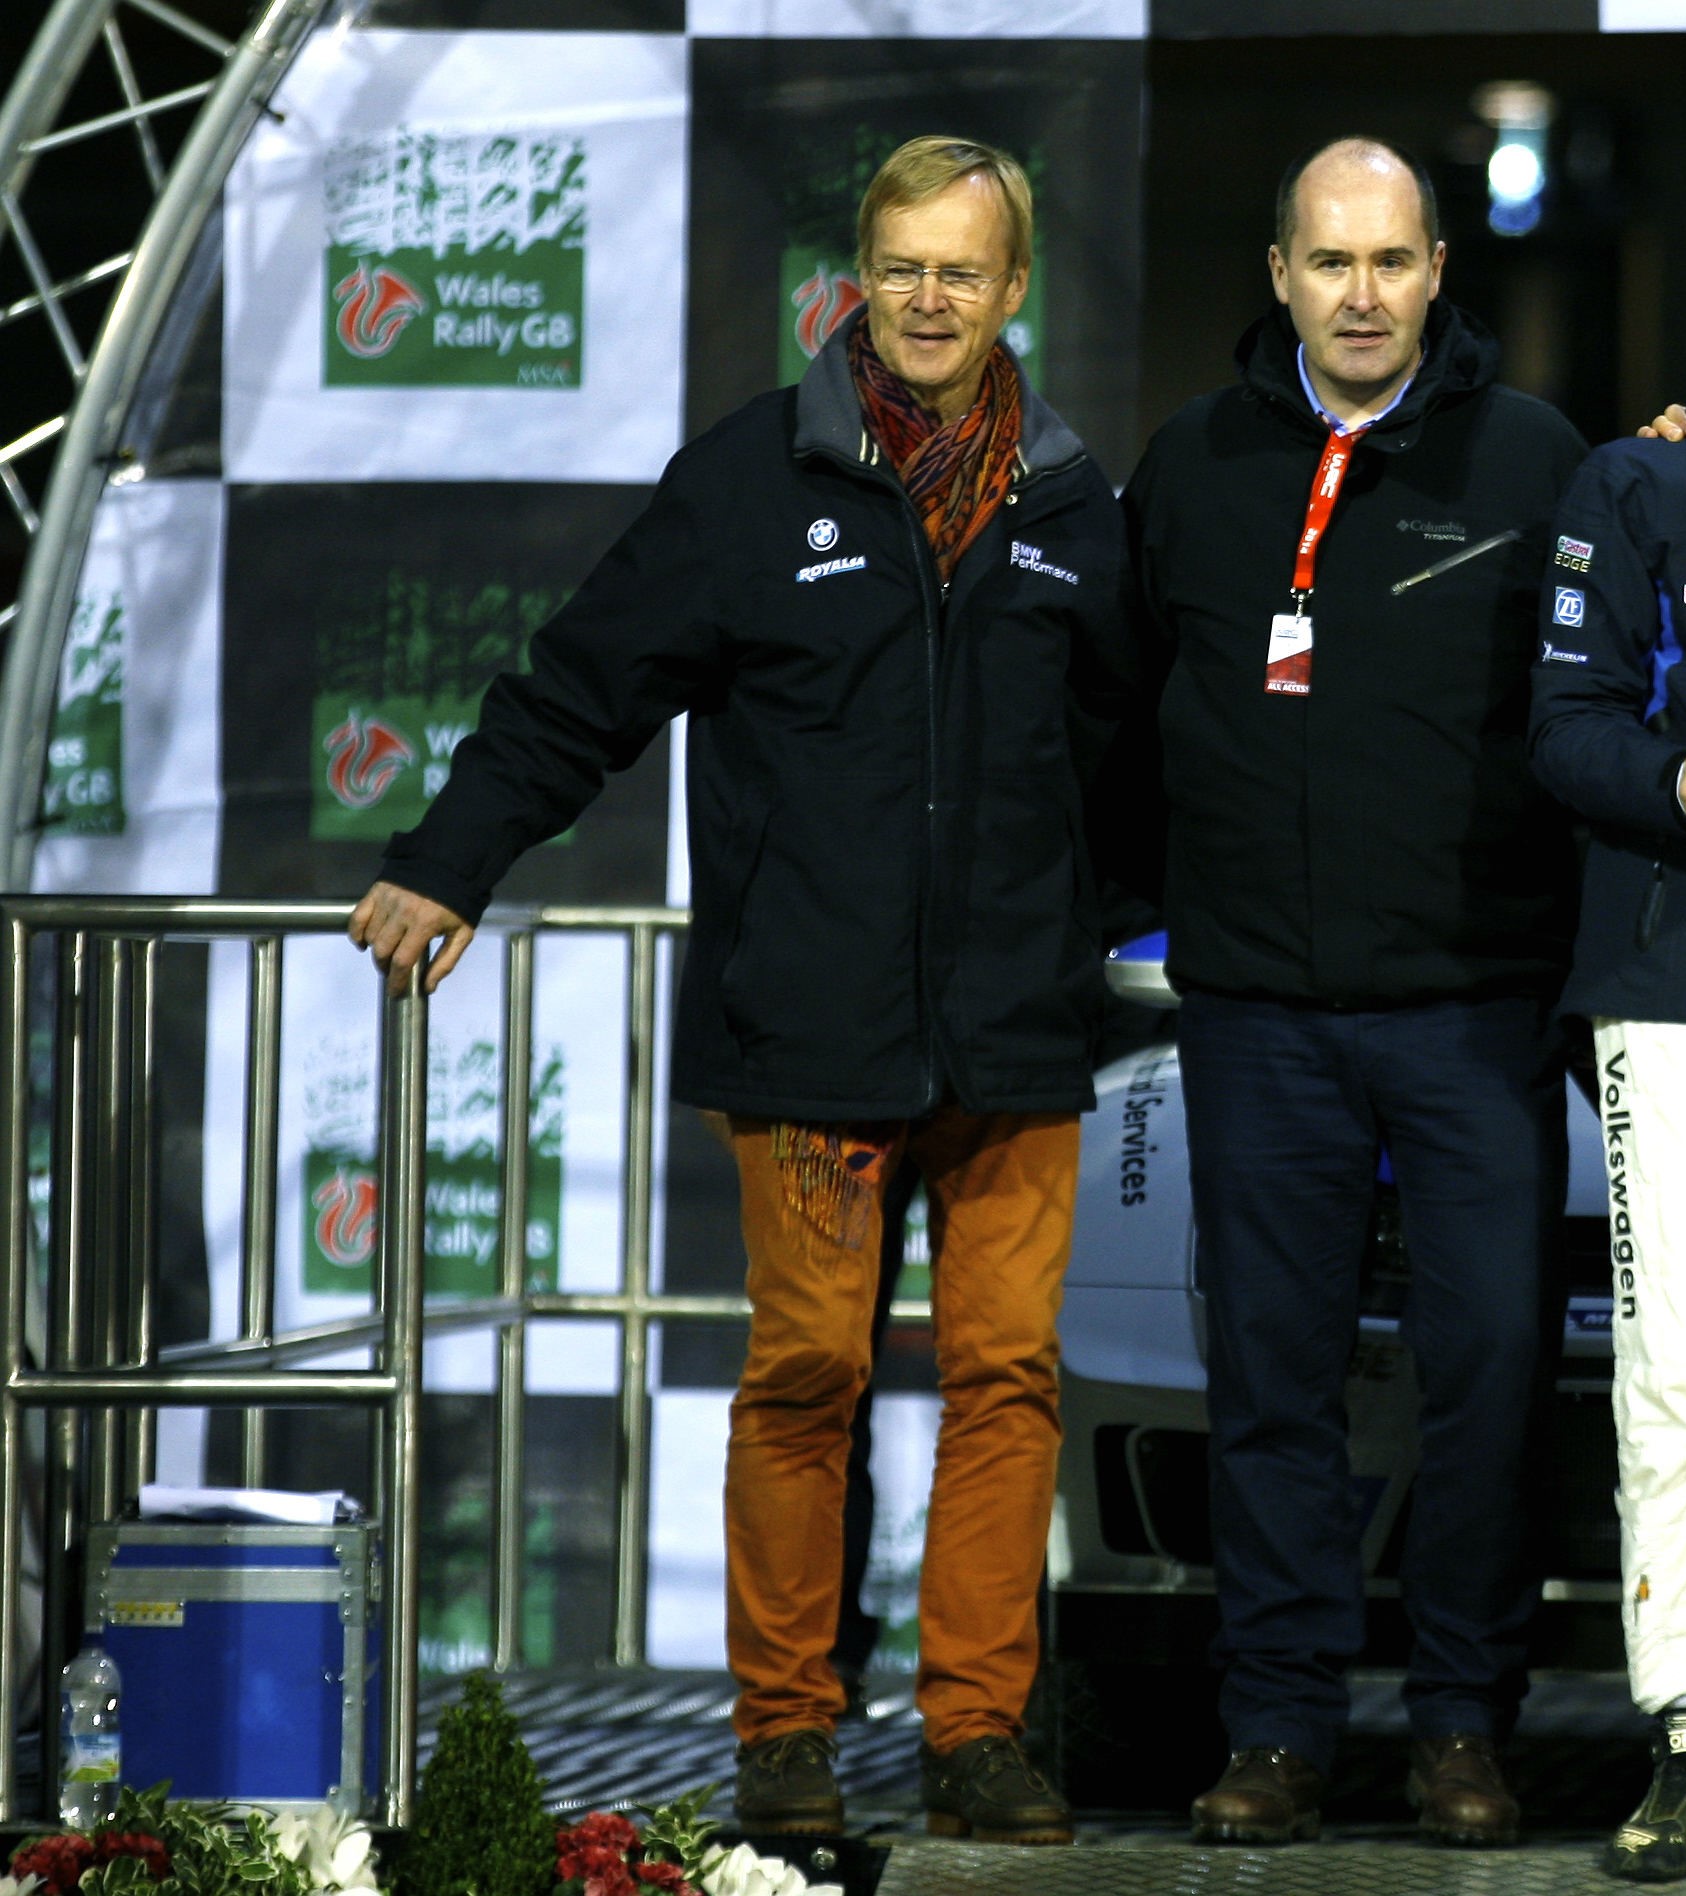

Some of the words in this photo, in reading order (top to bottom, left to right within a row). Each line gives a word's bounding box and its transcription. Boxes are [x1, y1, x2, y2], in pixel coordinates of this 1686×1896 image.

[434, 272, 544, 308] Wales
[432, 311, 519, 356] Rally
[520, 312, 576, 349] GB
[1010, 553, 1078, 585] Performance
[1011, 541, 1043, 561] BMW
[1554, 553, 1591, 573] EDGE
[1120, 1097, 1164, 1208] Services
[1604, 1050, 1637, 1321] Volkswagen
